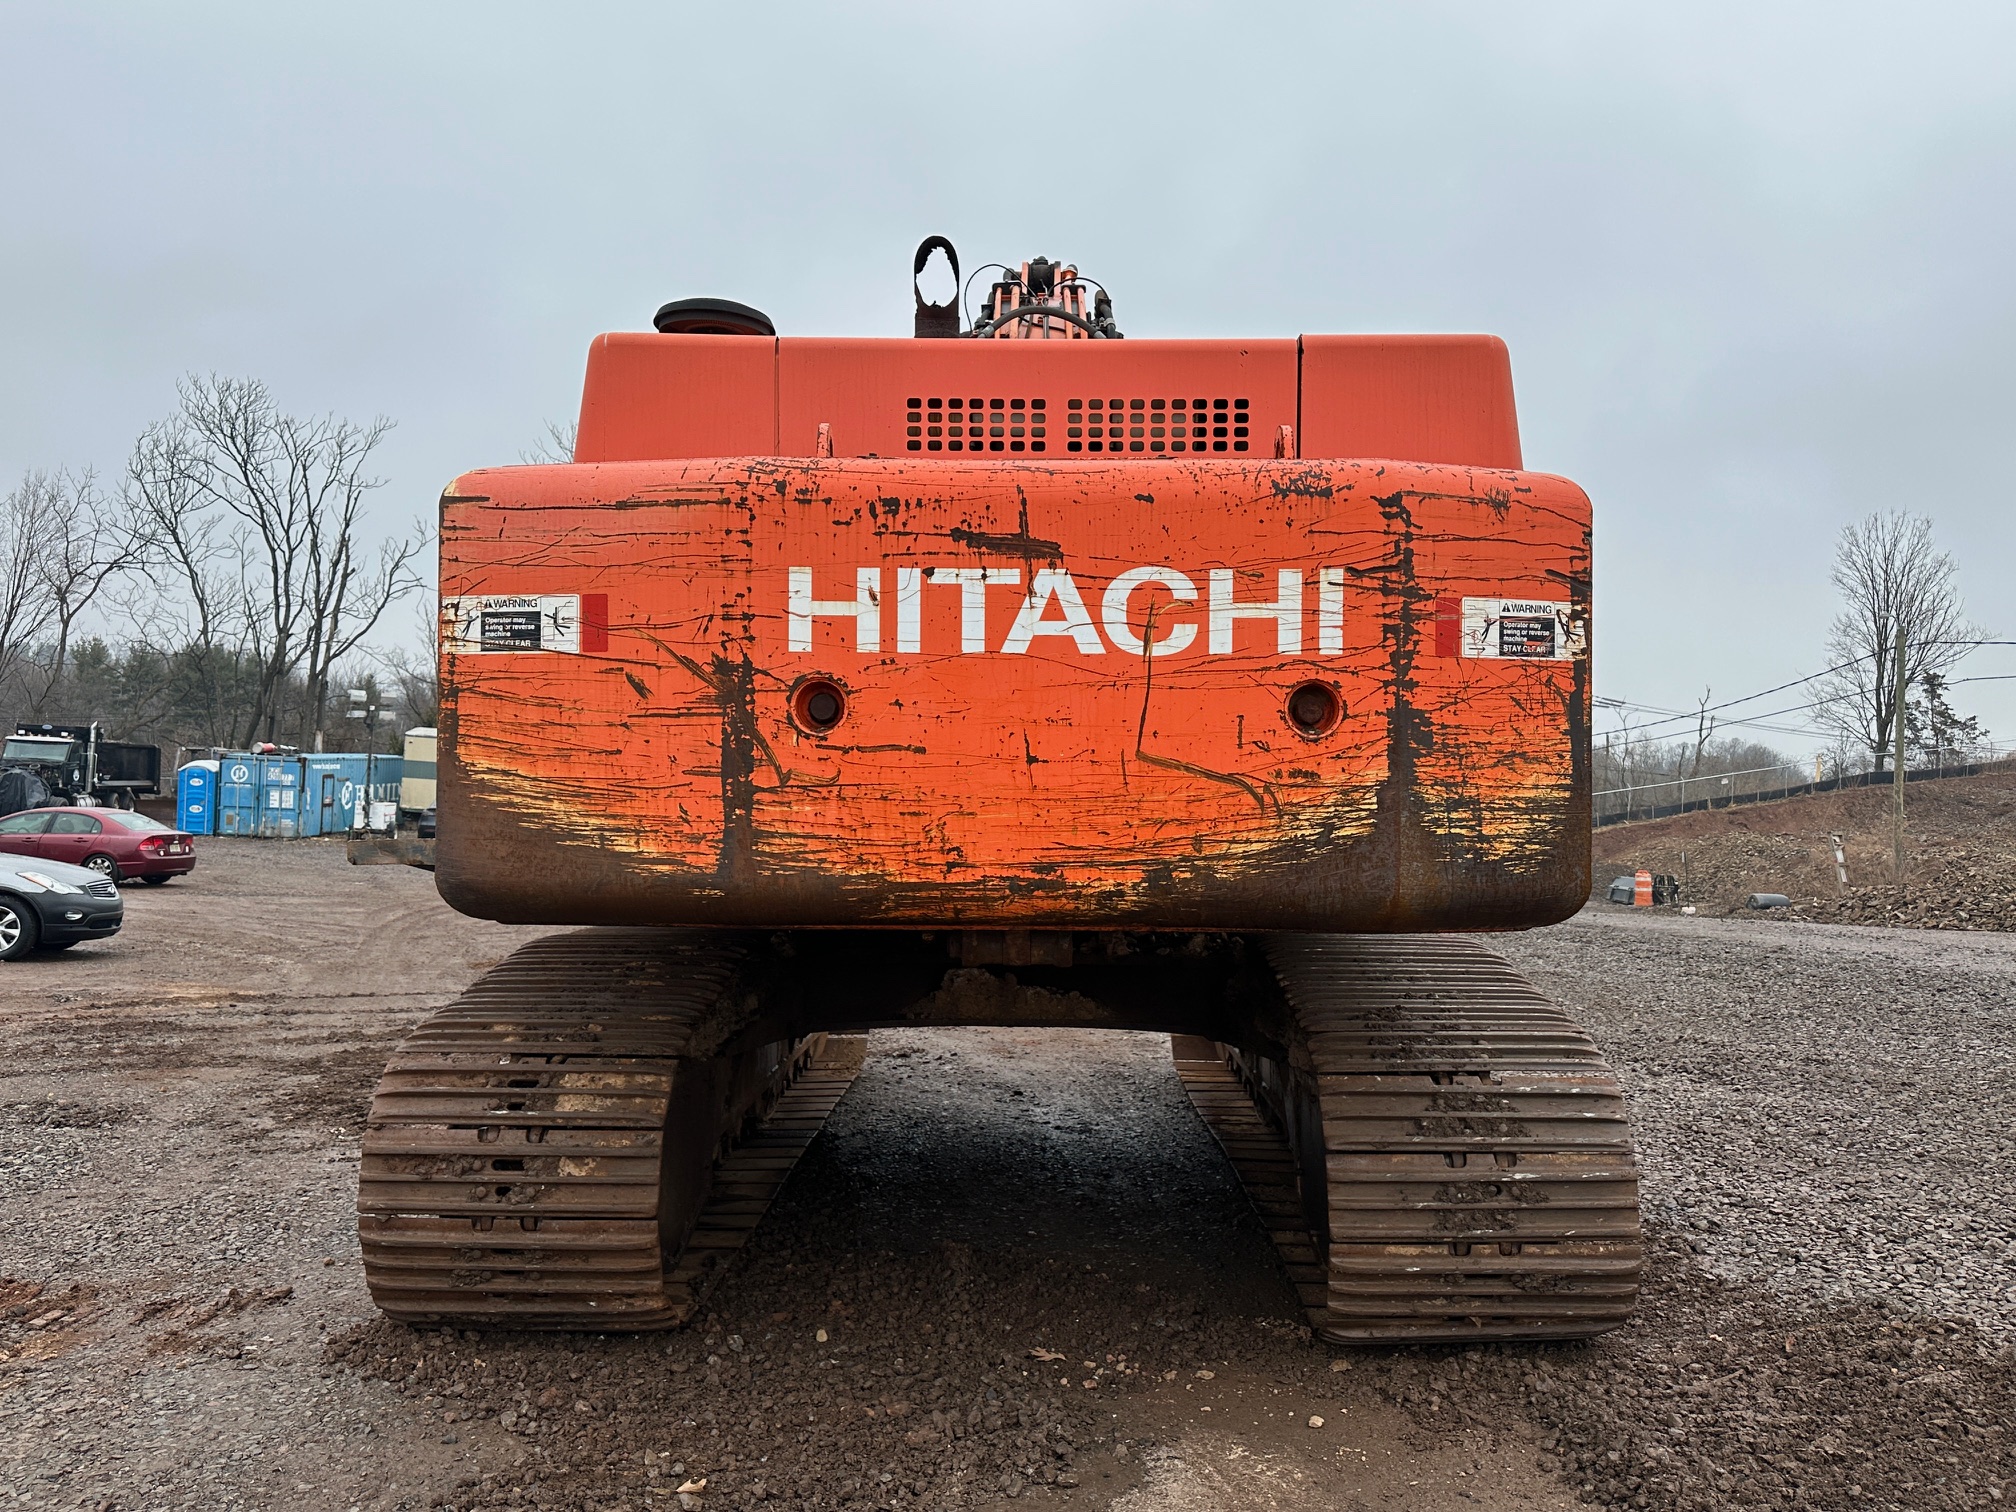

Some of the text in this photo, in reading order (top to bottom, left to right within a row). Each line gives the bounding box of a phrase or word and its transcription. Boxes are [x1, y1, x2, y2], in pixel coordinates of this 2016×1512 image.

[493, 599, 538, 608] WARNING
[787, 566, 1344, 656] HITACHI
[1511, 603, 1552, 614] WARNING
[1503, 621, 1528, 629] Operator
[1522, 645, 1546, 653] CLEAR
